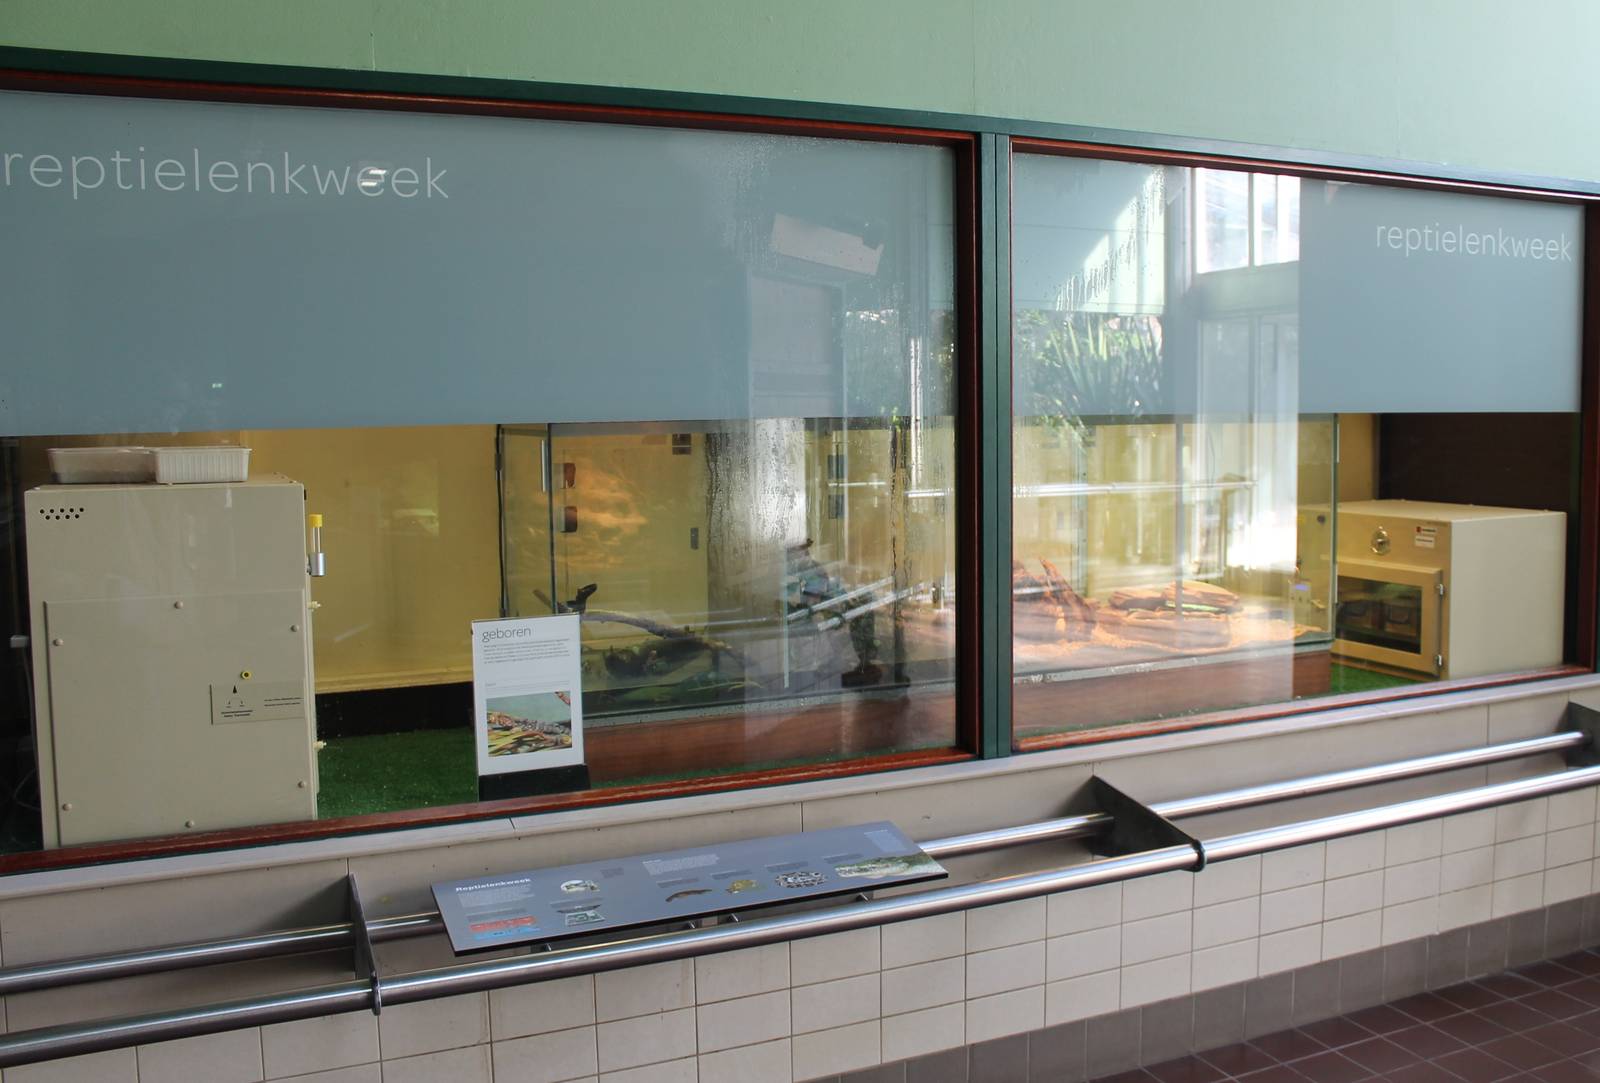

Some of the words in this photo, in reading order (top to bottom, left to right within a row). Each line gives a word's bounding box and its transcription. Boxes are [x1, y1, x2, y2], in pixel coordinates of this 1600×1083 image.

[3, 147, 449, 200] reptielenkweek
[1376, 222, 1572, 262] reptielenkweek
[481, 627, 532, 643] geboren
